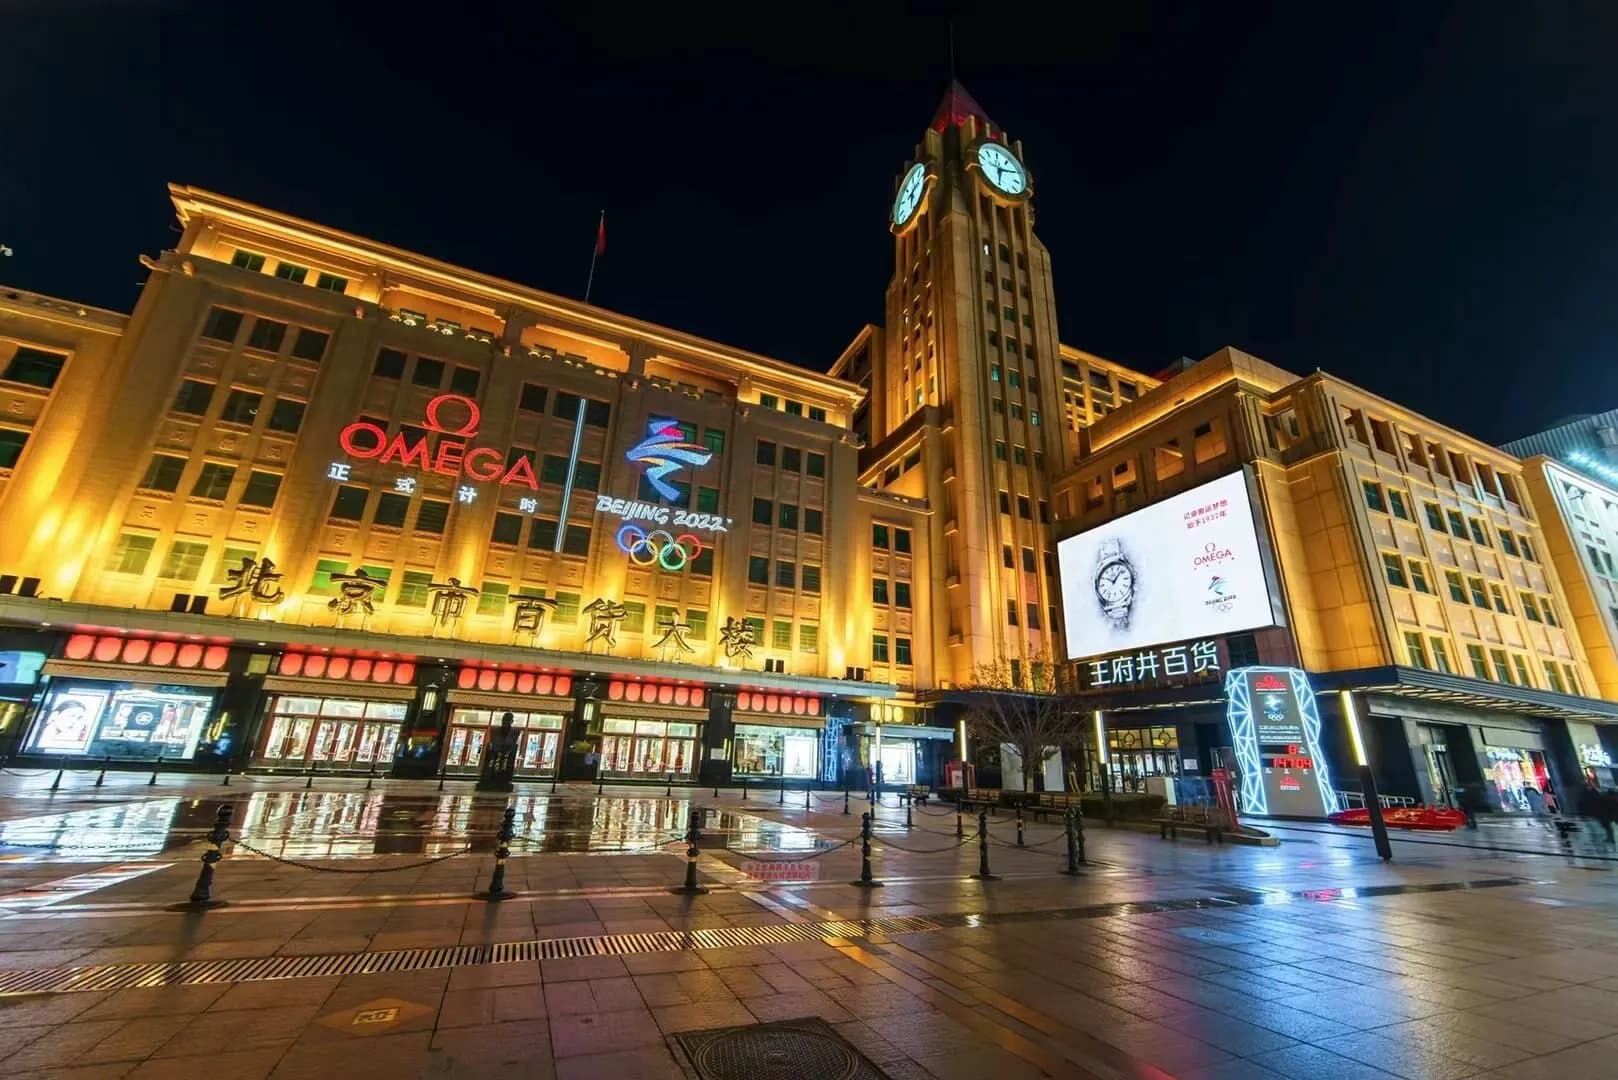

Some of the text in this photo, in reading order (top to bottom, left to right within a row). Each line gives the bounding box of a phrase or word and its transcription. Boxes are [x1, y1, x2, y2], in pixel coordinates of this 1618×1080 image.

[339, 422, 540, 491] OMEGA
[327, 462, 538, 513] 正式计时
[596, 495, 727, 532] BEIJING 2022
[1193, 549, 1232, 566] OMEGA
[218, 557, 757, 659] 北京市百货大楼
[1089, 640, 1220, 686] 王府井百货
